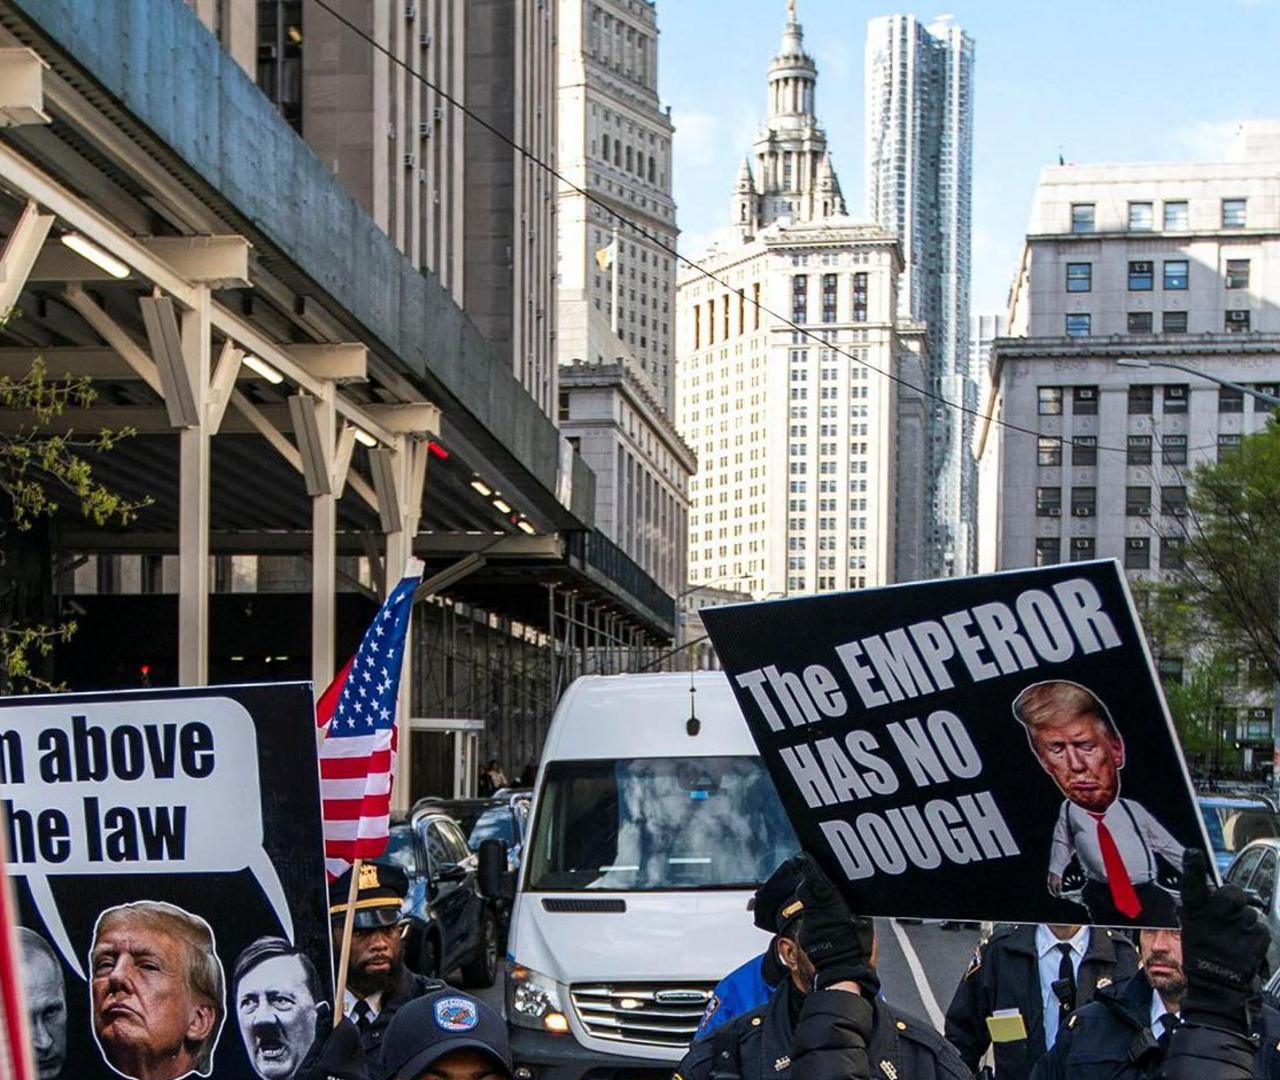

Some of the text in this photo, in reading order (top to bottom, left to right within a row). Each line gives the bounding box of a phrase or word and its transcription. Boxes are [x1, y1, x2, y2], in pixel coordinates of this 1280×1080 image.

[736, 578, 1123, 732] The EMPEROR
[37, 715, 215, 784] above
[779, 710, 983, 809] HAS NO
[83, 797, 187, 862] law
[819, 790, 1021, 881] DOUGH
